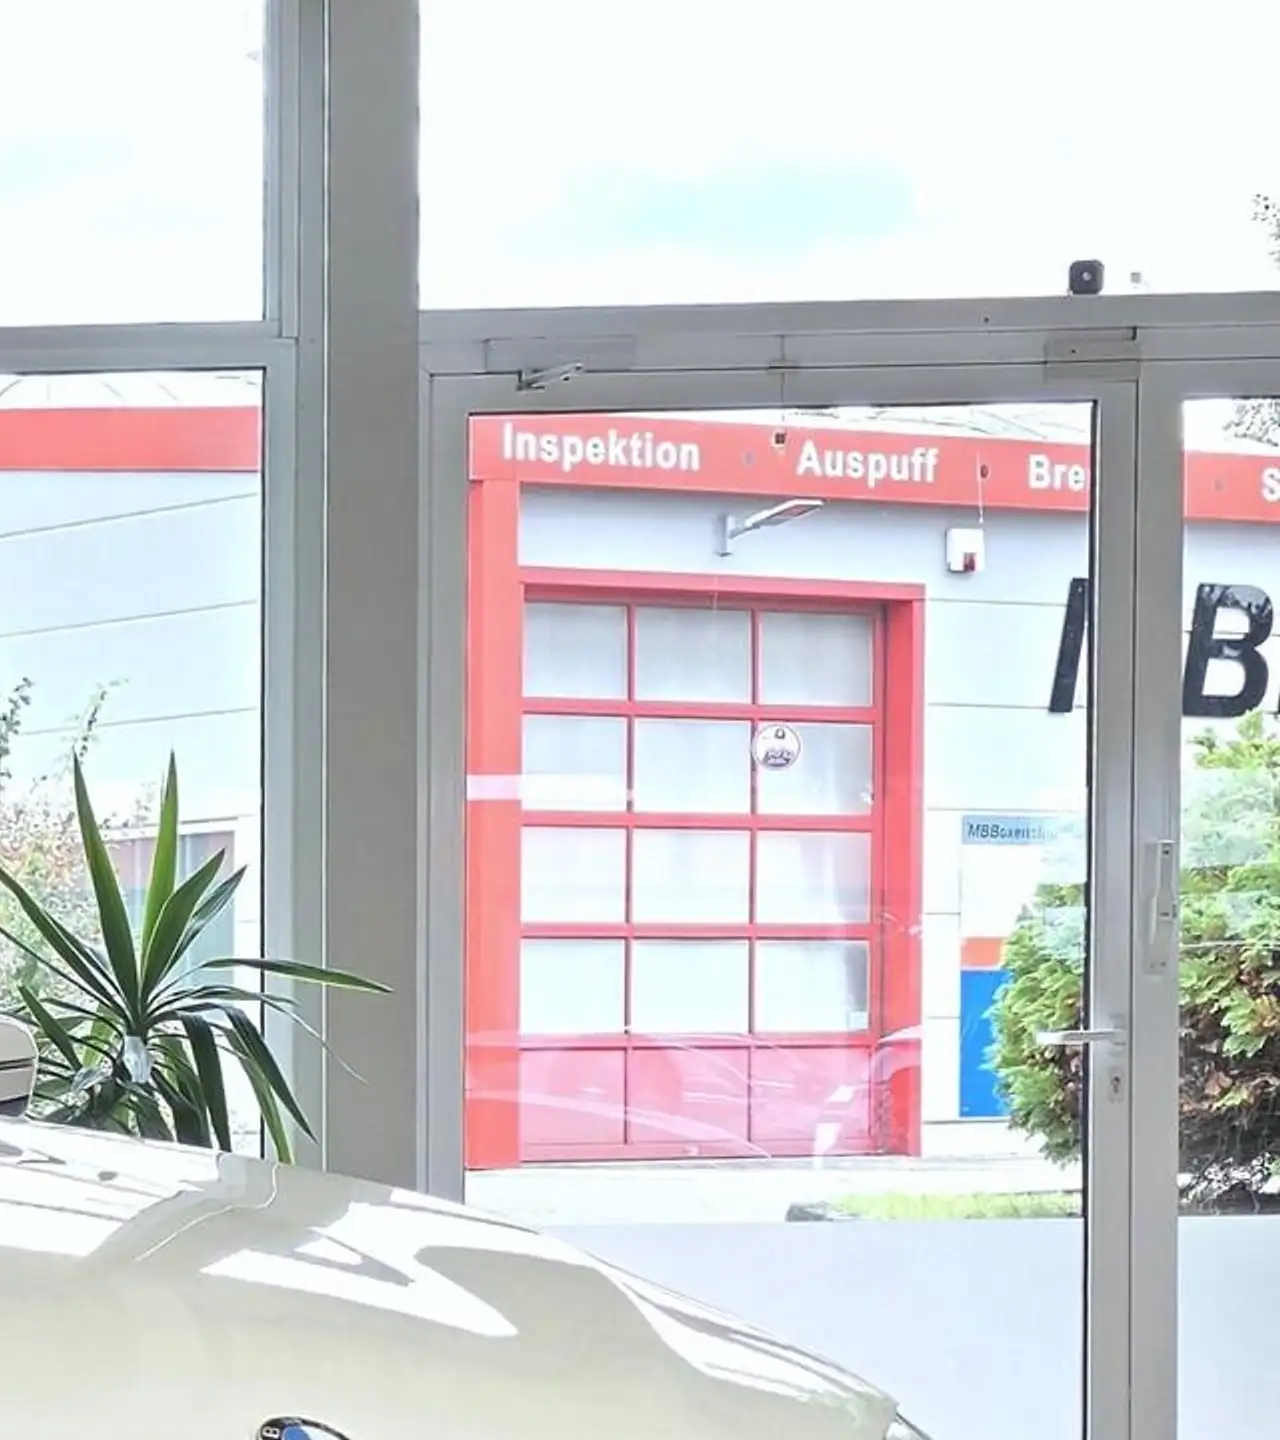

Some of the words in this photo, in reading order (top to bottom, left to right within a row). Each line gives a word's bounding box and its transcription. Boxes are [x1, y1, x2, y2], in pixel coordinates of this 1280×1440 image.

[502, 421, 700, 472] Inspektion
[796, 440, 939, 488] Auspuff
[1028, 453, 1090, 489] Bre
